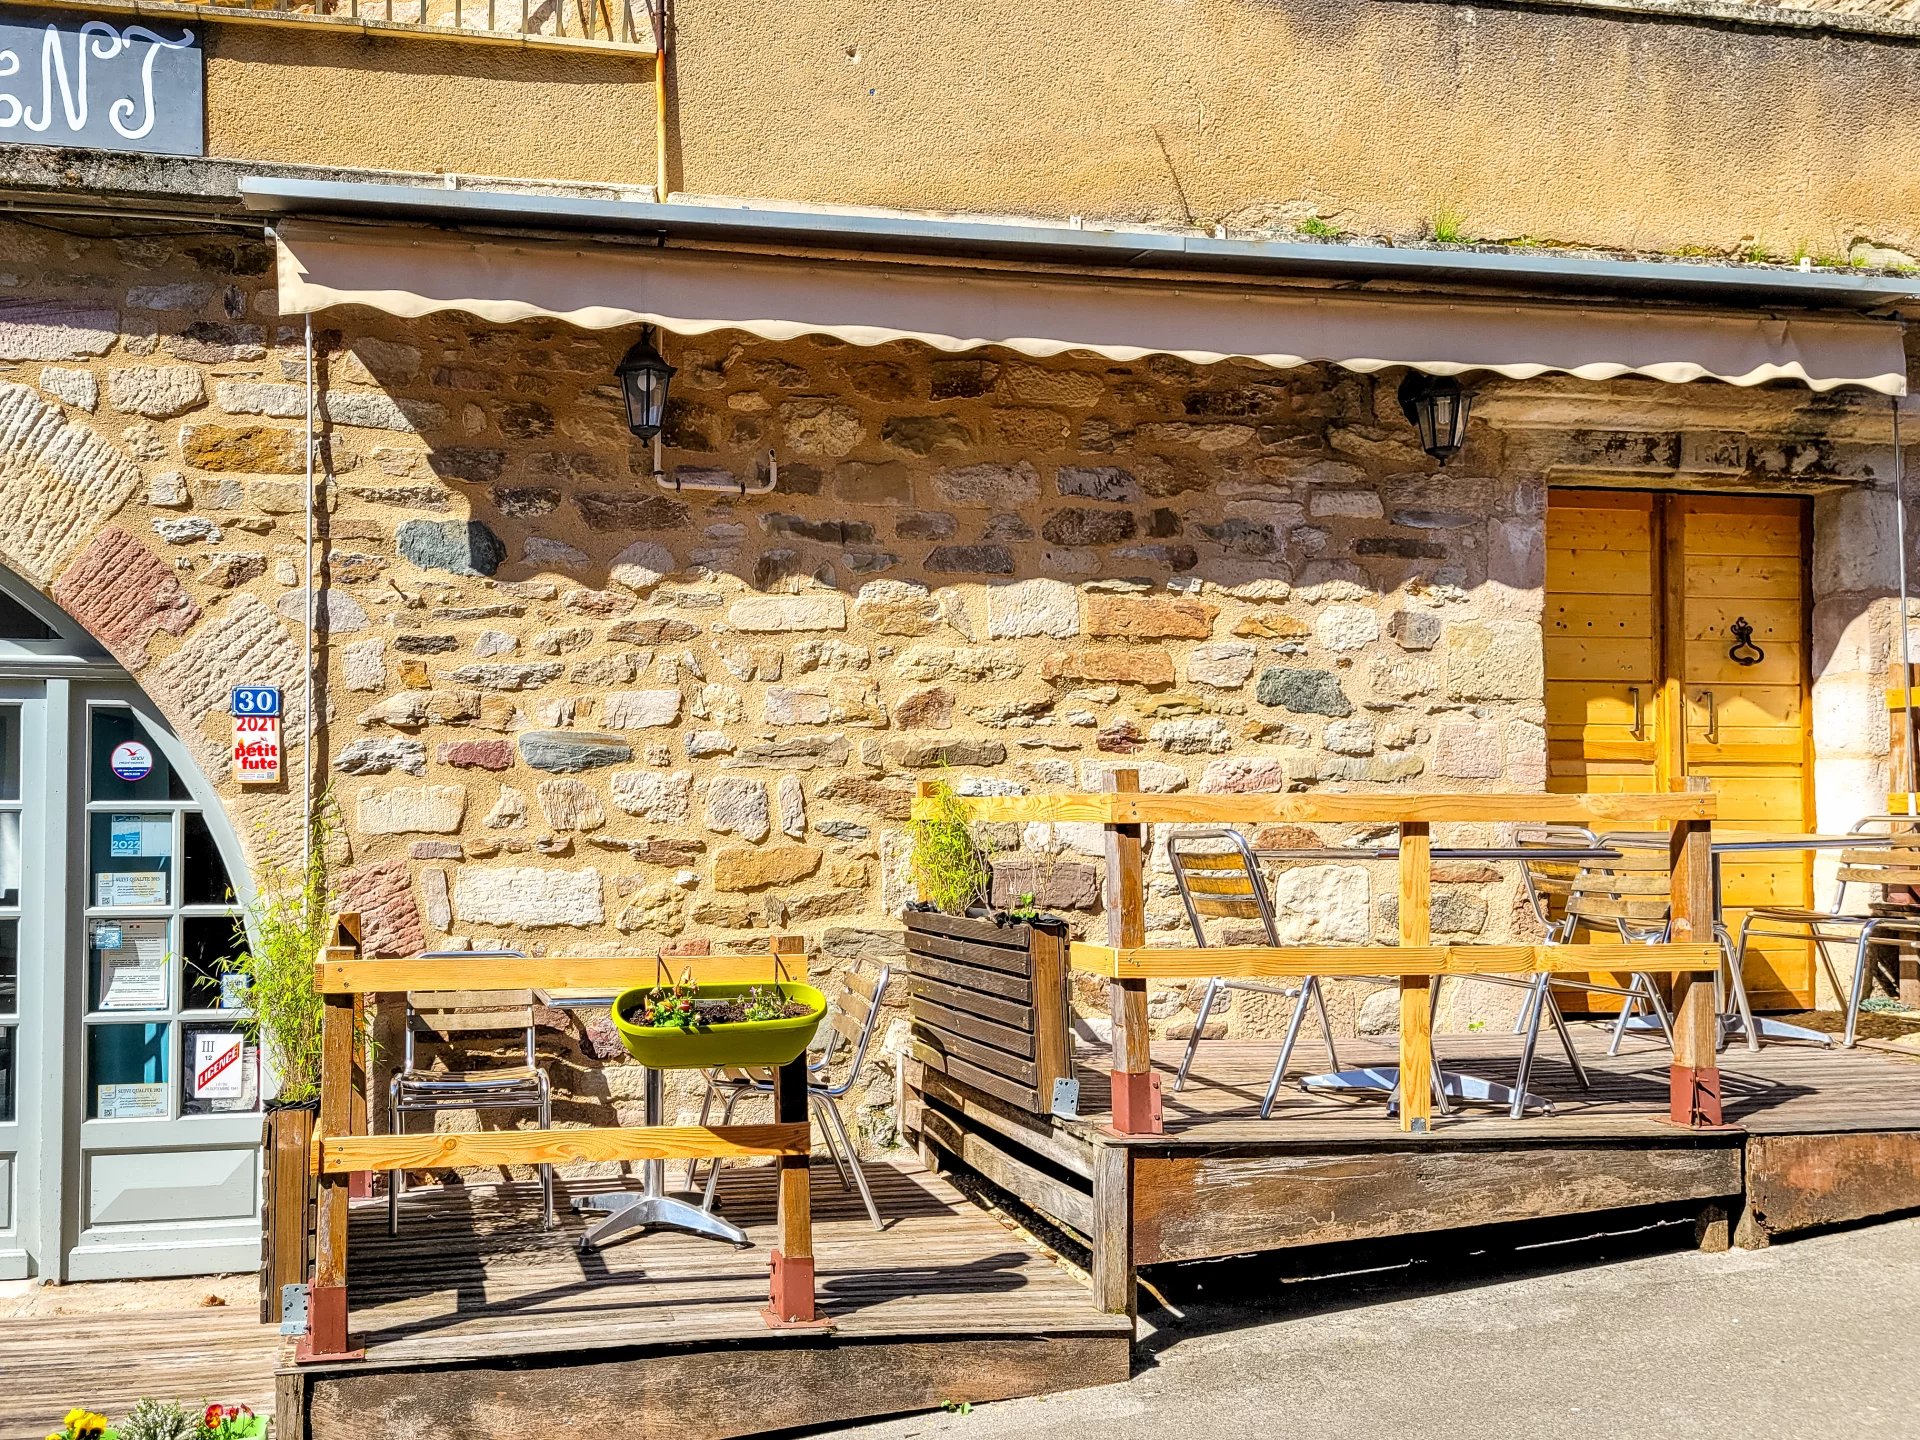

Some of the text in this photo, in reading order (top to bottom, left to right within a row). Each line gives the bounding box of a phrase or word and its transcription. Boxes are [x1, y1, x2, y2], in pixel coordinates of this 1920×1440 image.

[238, 691, 273, 712] 30
[237, 717, 275, 732] 2021
[113, 840, 140, 849] 2022
[202, 1040, 215, 1053] III
[199, 1043, 239, 1084] LICENCE
